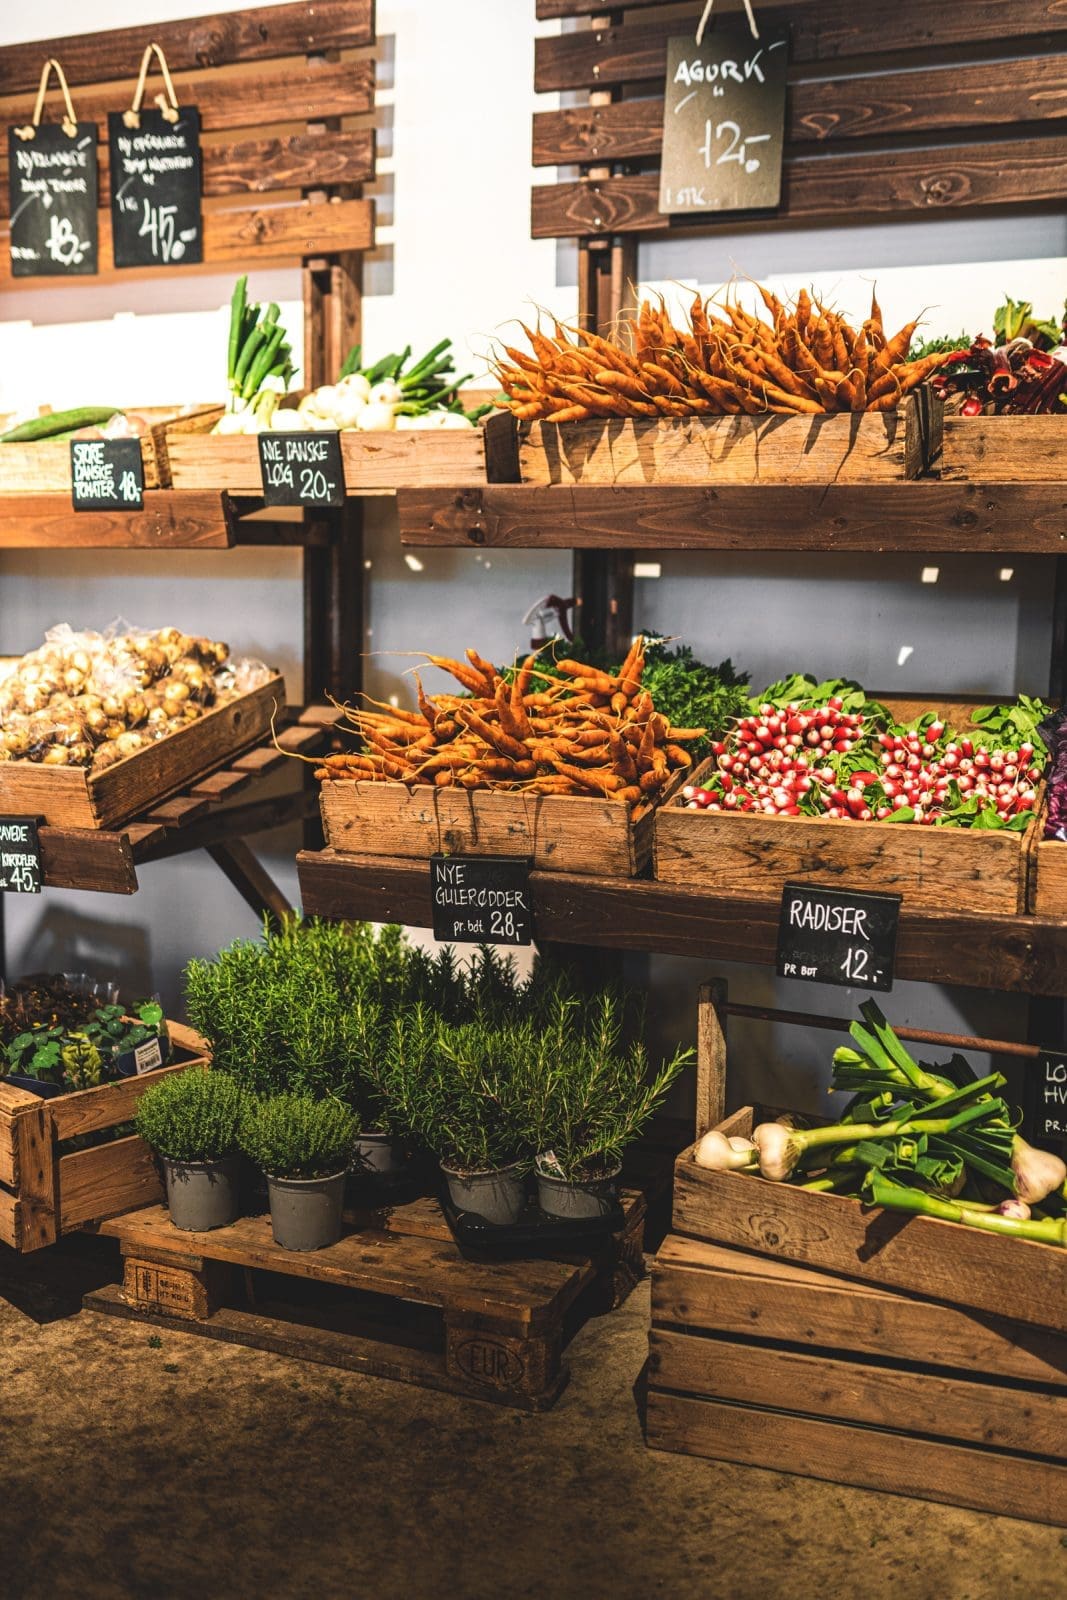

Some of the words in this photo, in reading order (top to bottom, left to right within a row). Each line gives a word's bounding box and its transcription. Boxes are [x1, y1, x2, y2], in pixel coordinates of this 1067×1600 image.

[673, 49, 765, 87] AGURK
[436, 863, 467, 885] NYE
[789, 899, 871, 941] RADISER
[783, 962, 797, 977] PR
